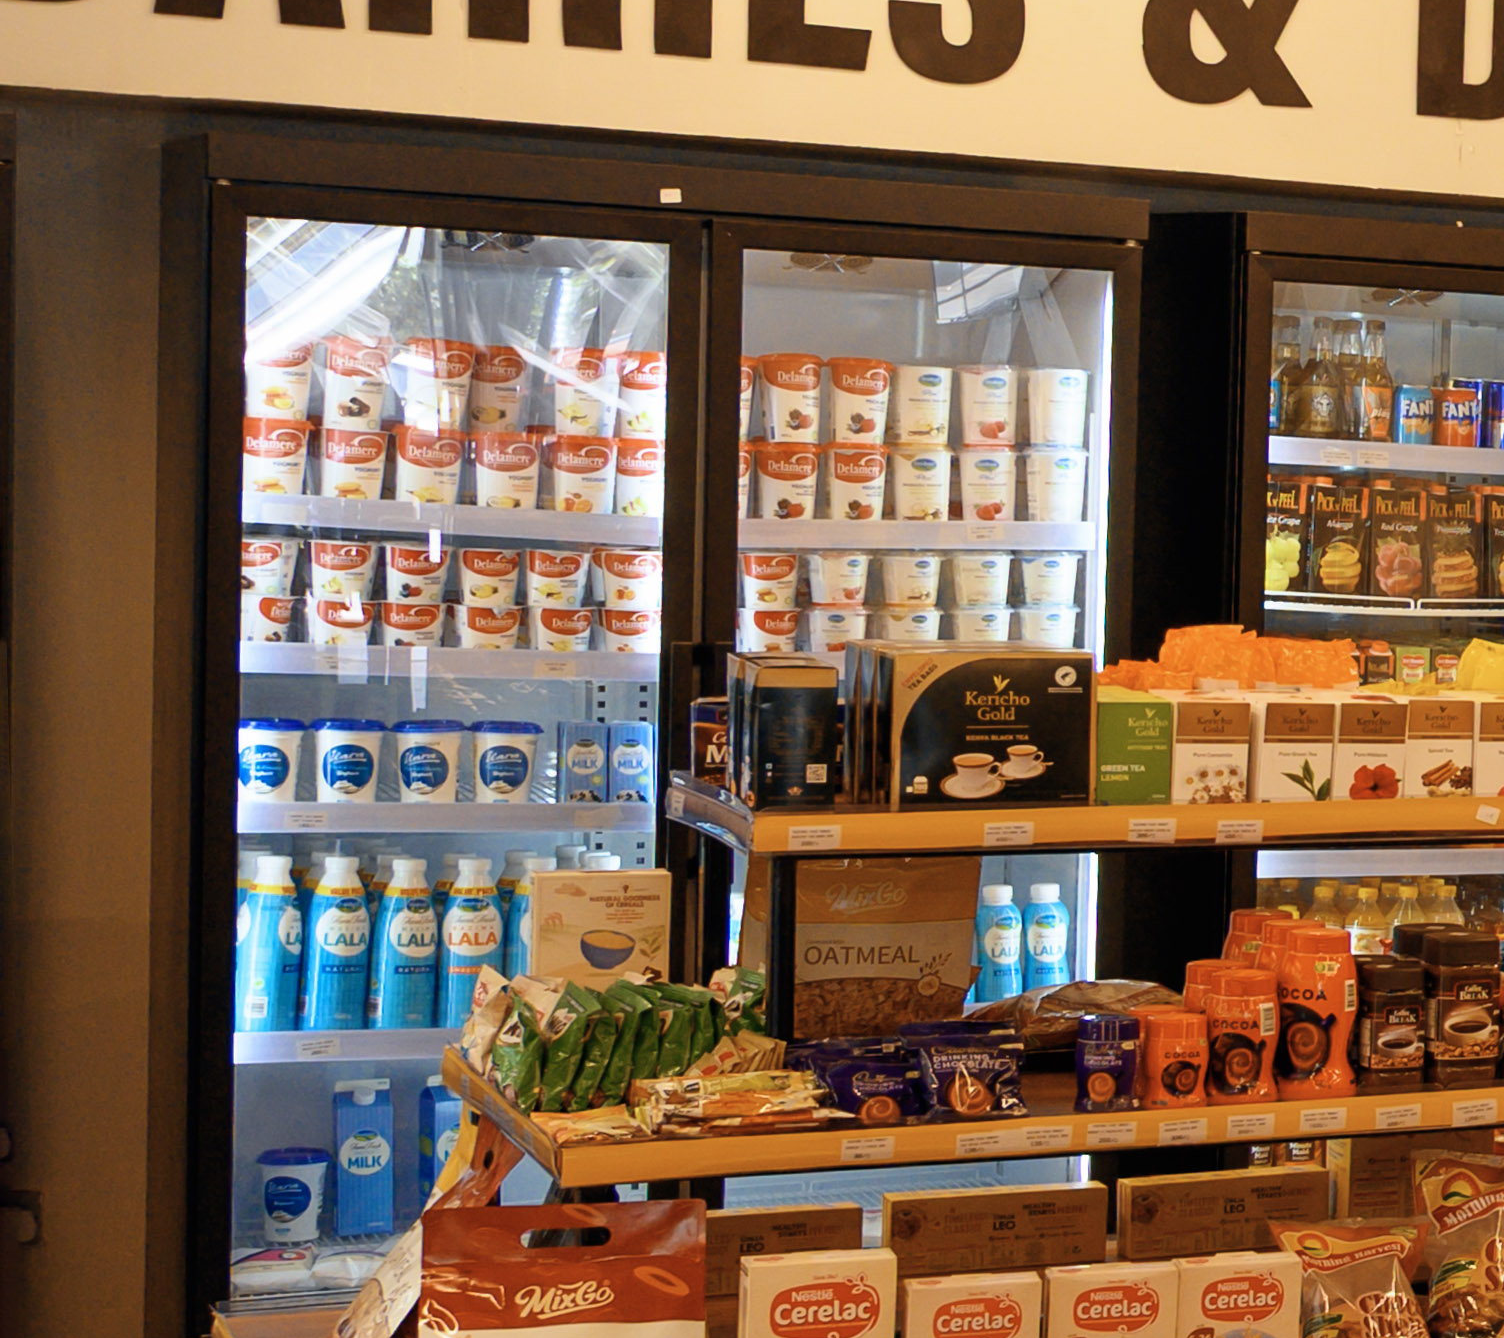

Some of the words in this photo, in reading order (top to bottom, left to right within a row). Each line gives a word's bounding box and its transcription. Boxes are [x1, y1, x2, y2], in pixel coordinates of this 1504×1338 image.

[246, 436, 297, 452] Delamere
[328, 442, 378, 457] Delamere
[409, 445, 458, 460] Delamere
[483, 450, 529, 464] Delamere
[965, 691, 1030, 706] Kericho
[977, 707, 1015, 722] Gold
[1128, 717, 1168, 728] Kericho
[1135, 727, 1159, 738] Gold
[571, 758, 599, 769] MILK
[616, 758, 645, 770] MILK
[1101, 764, 1126, 773] GREEN
[1129, 764, 1145, 772] TEA
[1101, 774, 1129, 782] LEMON
[323, 930, 368, 947] LALA
[448, 930, 498, 946] LALA
[803, 944, 920, 967] OATMEAL
[1032, 945, 1064, 958] LALA
[1211, 1019, 1259, 1030] COCOA
[933, 1052, 991, 1064] DRINKING
[346, 1154, 383, 1169] MILK
[1223, 1202, 1246, 1214] LEO
[993, 1220, 1016, 1231] LEO
[740, 1241, 765, 1254] LEO
[514, 1279, 615, 1320] MixGo
[1204, 1289, 1278, 1310] Cerelac
[770, 1299, 873, 1325] Cerelac
[1077, 1299, 1153, 1321] Cerelac
[936, 1309, 1017, 1334] Cerelac
